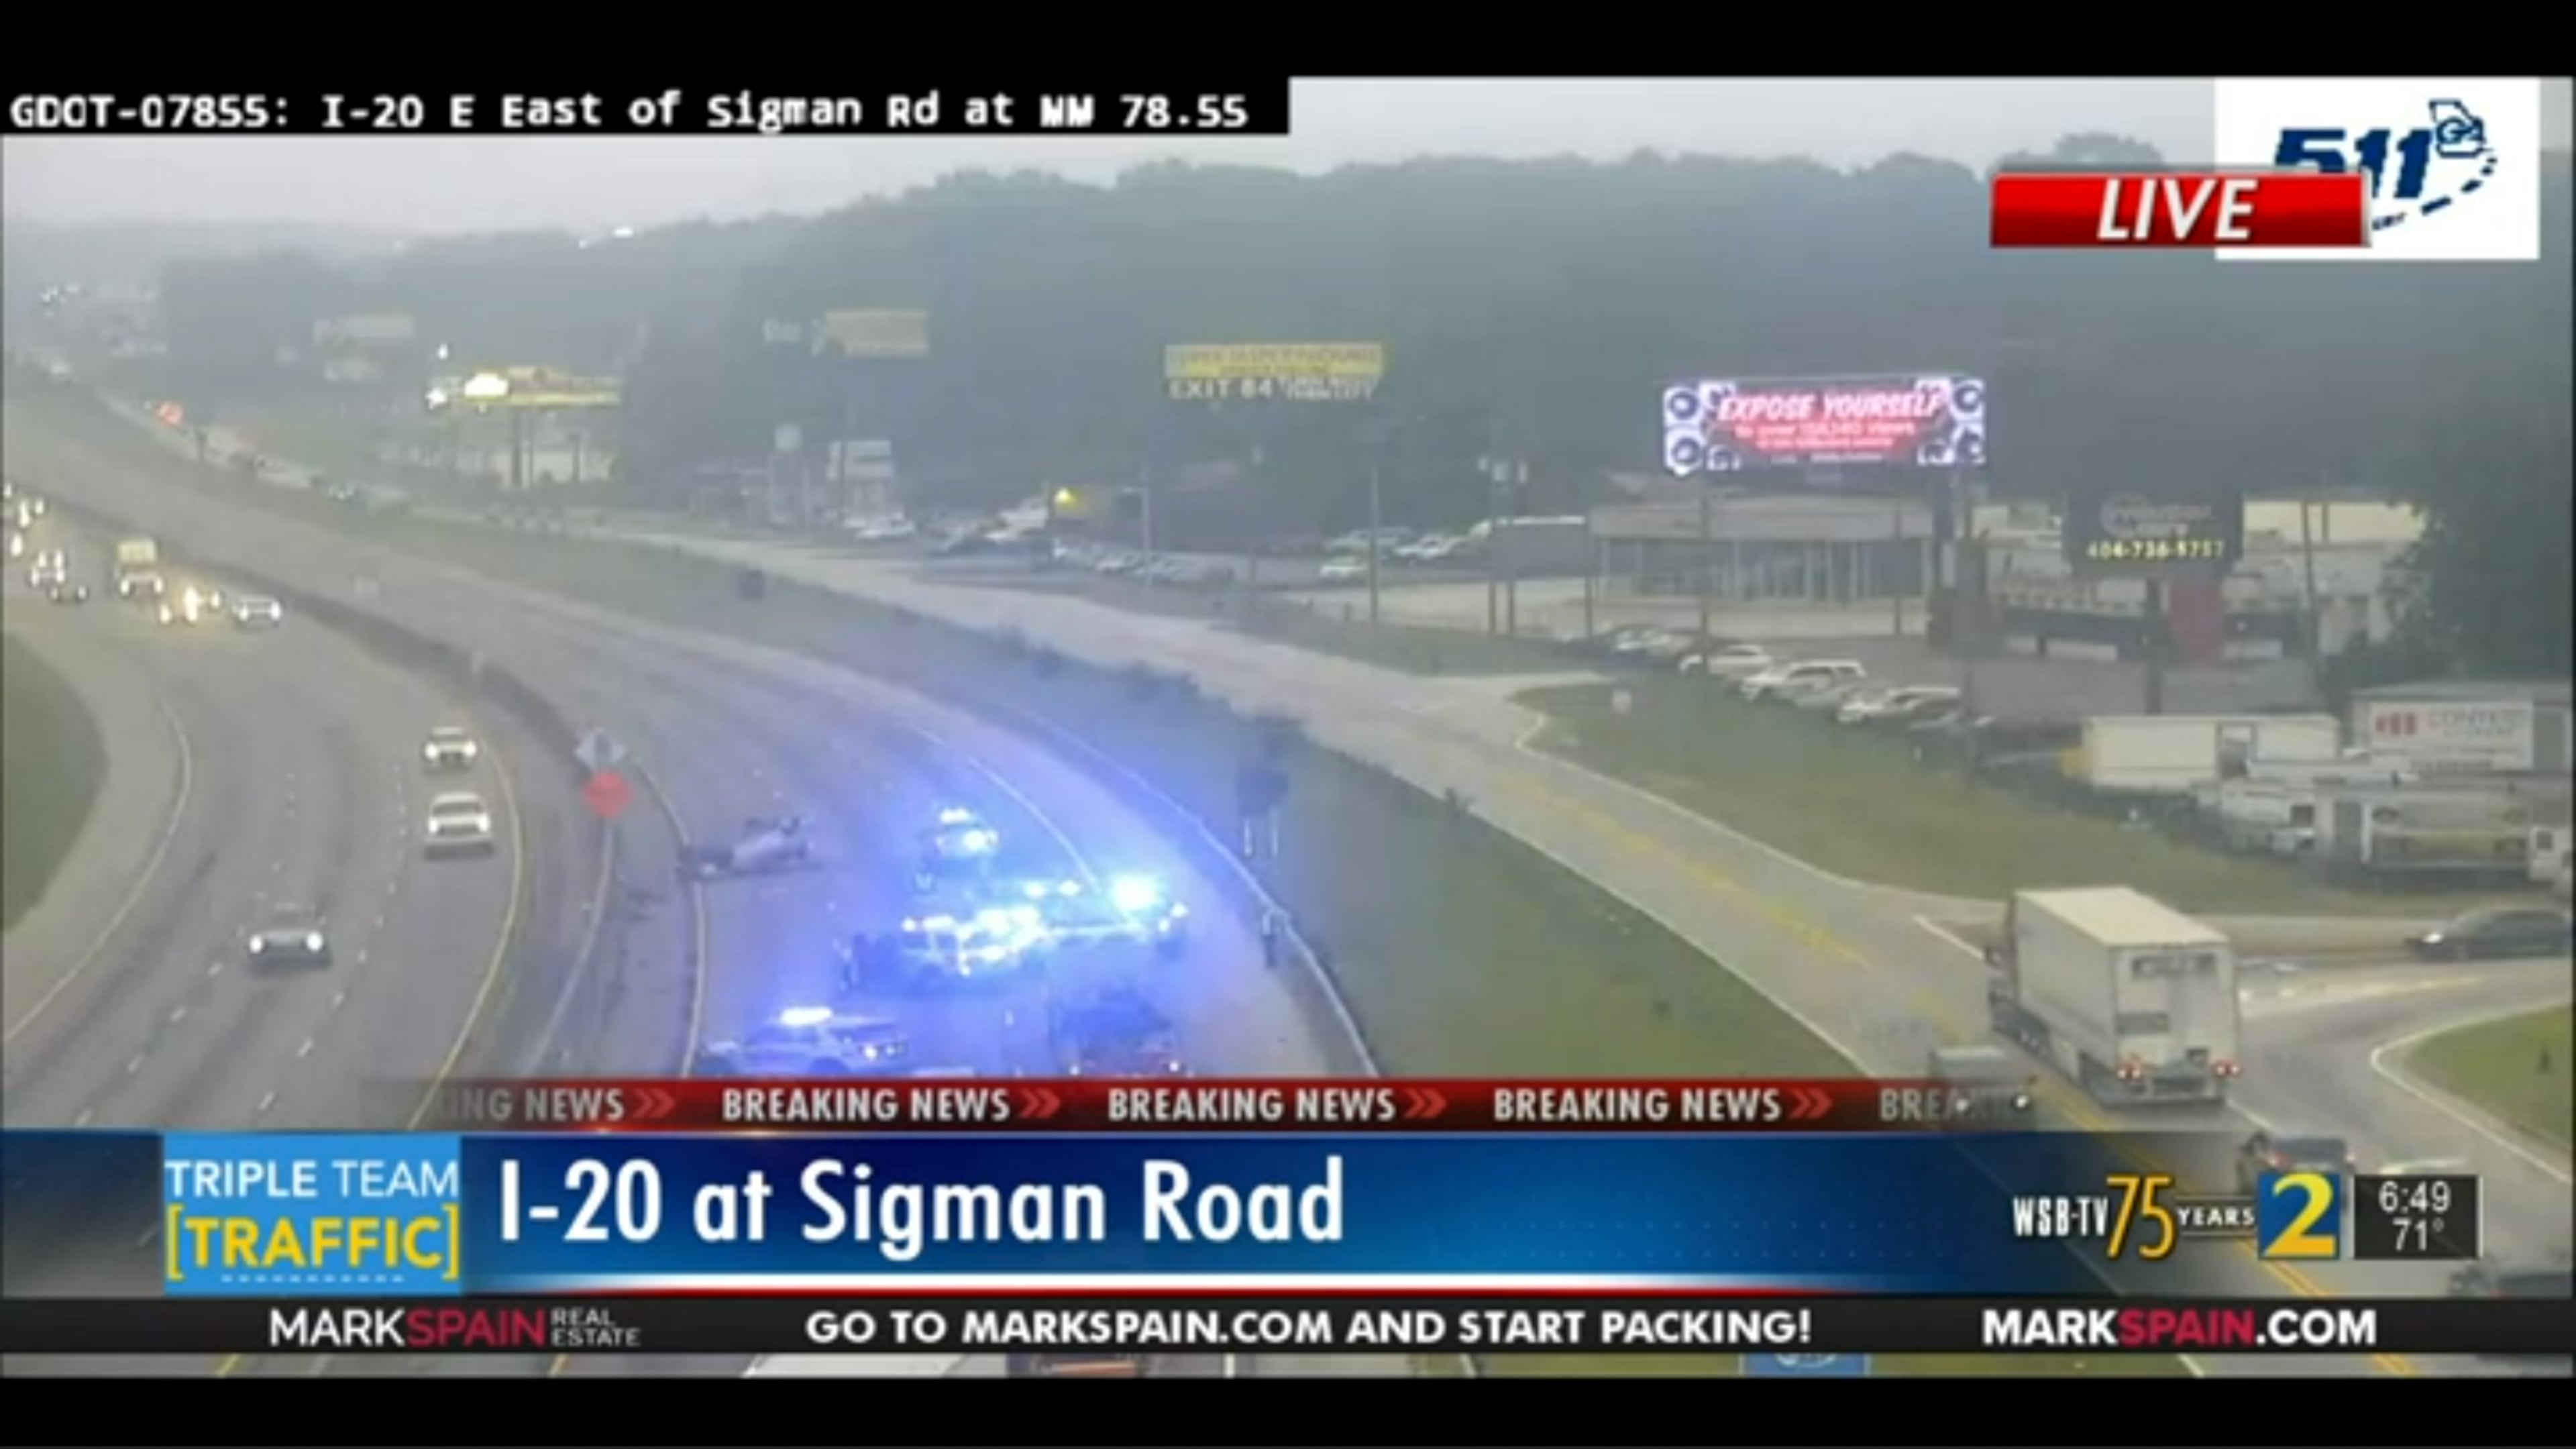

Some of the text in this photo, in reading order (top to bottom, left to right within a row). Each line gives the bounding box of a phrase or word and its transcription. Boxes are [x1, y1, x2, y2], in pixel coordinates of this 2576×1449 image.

[1169, 377, 1230, 400] EXIT
[1717, 390, 1940, 421] EXPOSE YOURSELF
